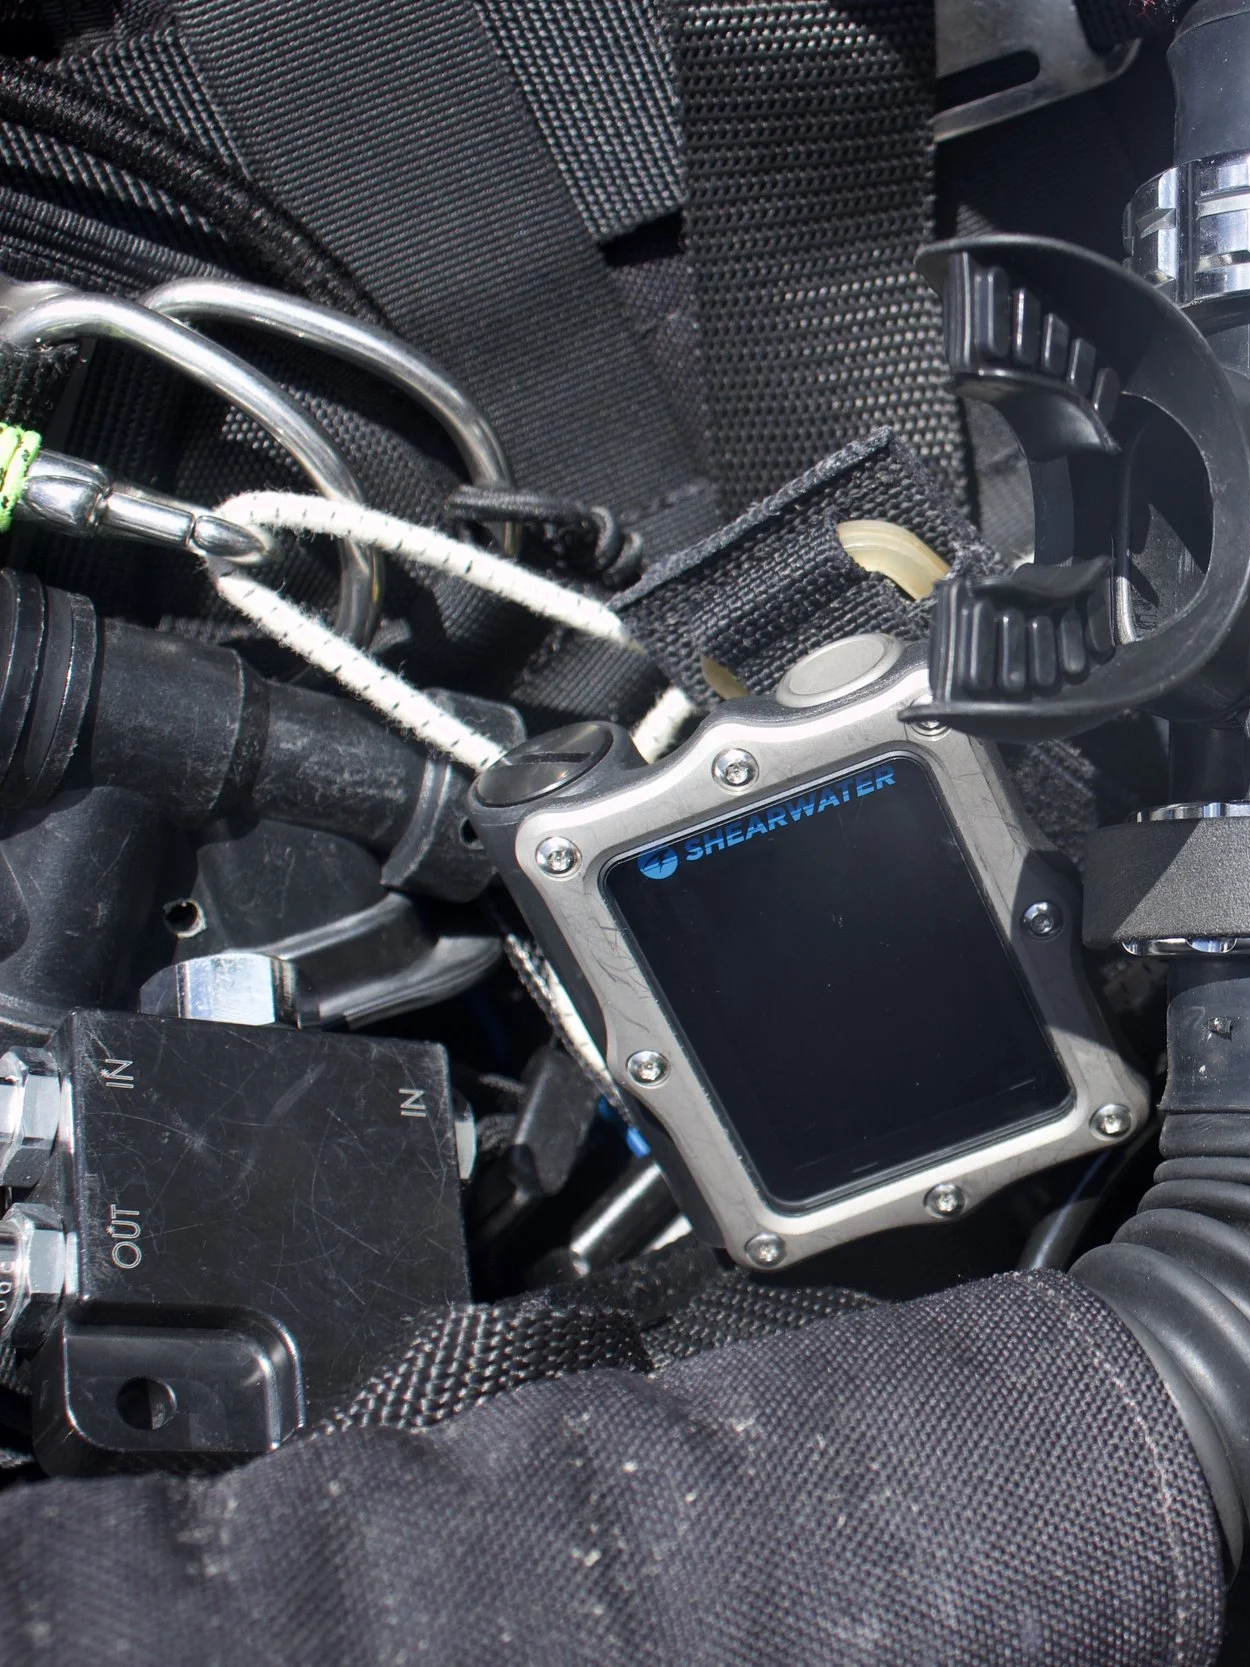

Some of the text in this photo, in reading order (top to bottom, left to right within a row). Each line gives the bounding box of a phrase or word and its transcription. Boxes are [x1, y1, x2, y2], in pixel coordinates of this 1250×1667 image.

[685, 765, 896, 861] SHEARWATER
[104, 1058, 134, 1089] IN
[399, 1088, 426, 1118] IN
[111, 1203, 142, 1270] OUT
